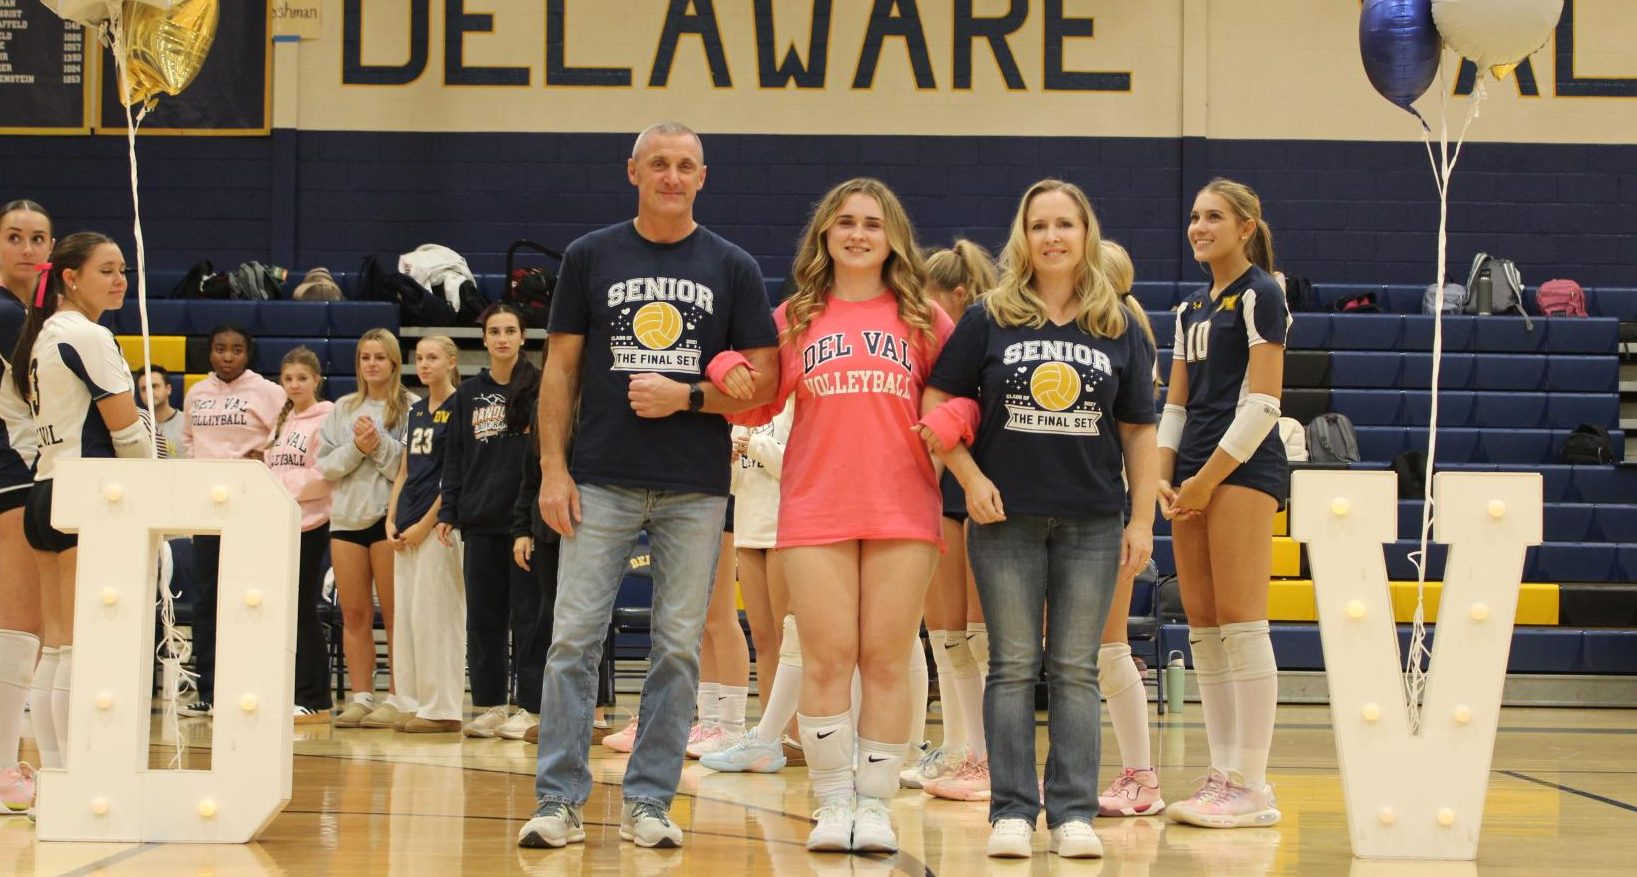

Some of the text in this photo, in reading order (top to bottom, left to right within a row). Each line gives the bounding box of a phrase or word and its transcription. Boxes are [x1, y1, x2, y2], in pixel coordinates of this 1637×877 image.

[607, 276, 714, 315] SENIOR
[803, 330, 913, 376] DEL VAL
[1003, 339, 1113, 376] SENIOR
[1187, 319, 1212, 364] 10
[616, 353, 697, 367] THE FINAL SET
[803, 369, 912, 400] VOLLEYBALL
[1013, 412, 1093, 429] THE FINAL SET
[410, 427, 435, 455] 23
